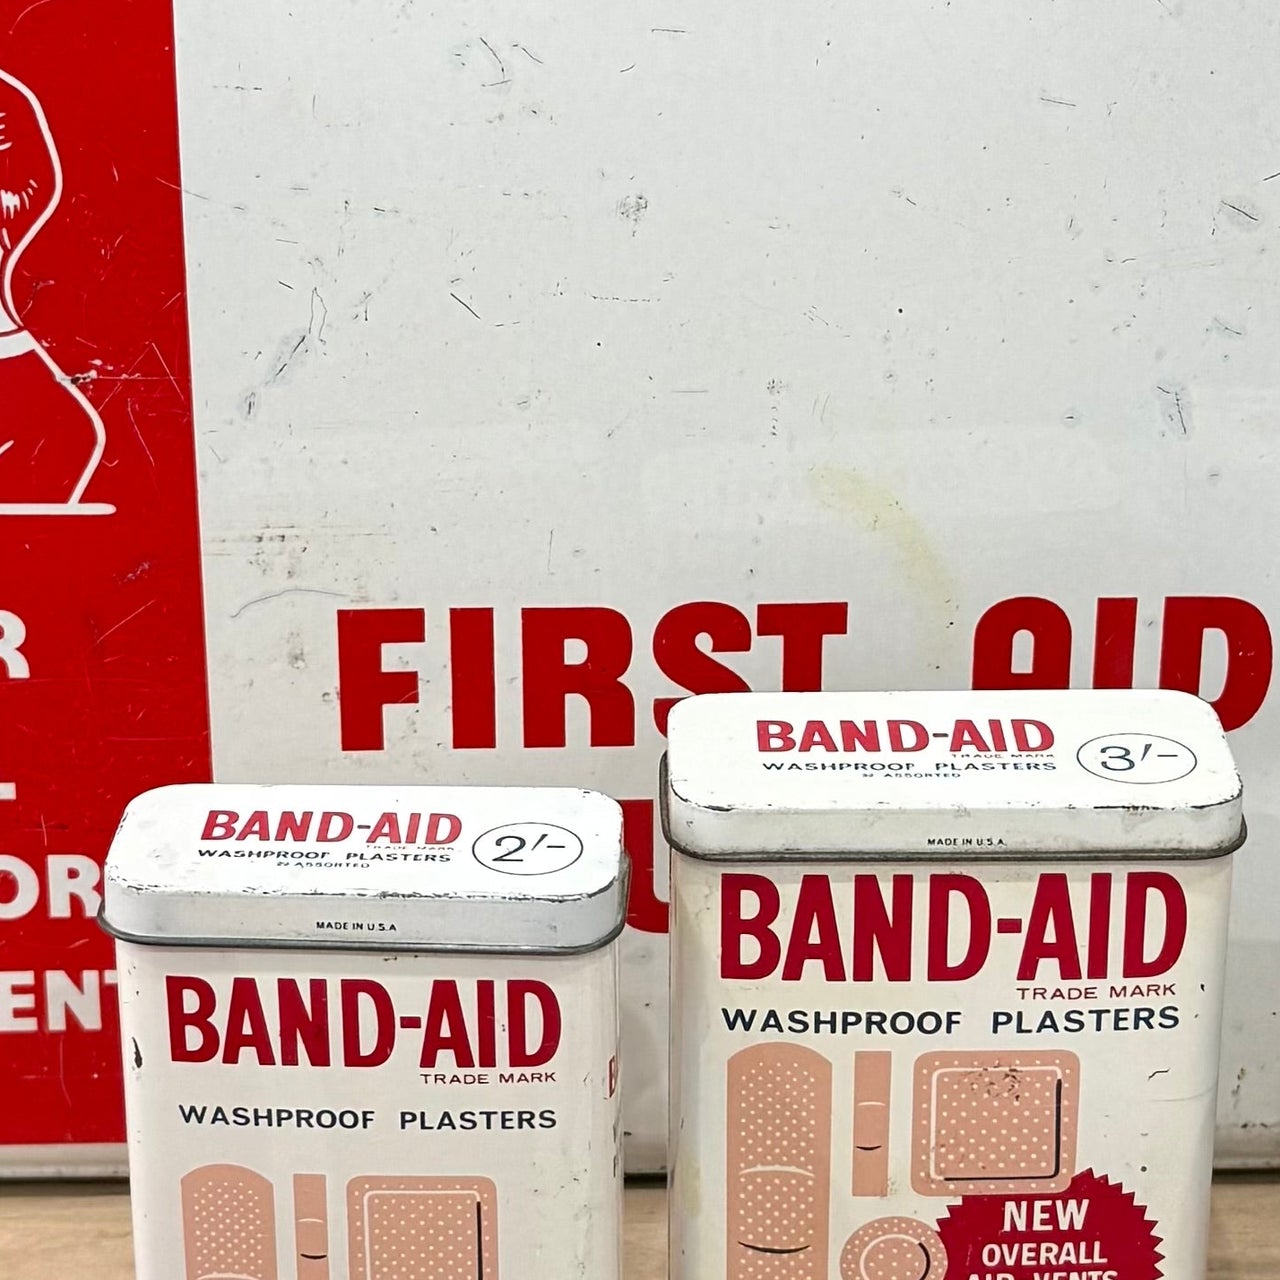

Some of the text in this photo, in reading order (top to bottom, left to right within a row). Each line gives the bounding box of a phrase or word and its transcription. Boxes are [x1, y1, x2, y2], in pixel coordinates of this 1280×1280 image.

[335, 595, 1274, 751] FIRST AID
[756, 719, 1054, 753] BAND-AID
[763, 761, 1057, 772] WASHPROOF PLASTERS
[200, 809, 463, 845] BAND-AID
[197, 848, 452, 863] WASHPROOF PLASTERS
[927, 837, 958, 847] MADE
[962, 838, 973, 846] IN
[316, 921, 349, 930] MADE
[352, 922, 364, 930] IN
[720, 871, 1187, 982] BAND-AID
[1016, 983, 1177, 1001] TRADE MARK
[165, 974, 562, 1069] BAND-AID
[721, 1005, 1181, 1035] WASHPROOF PLASTERS
[420, 1071, 558, 1085] TRADE MARK
[178, 1104, 558, 1131] WASHPROOF PLASTERS
[1002, 1198, 1090, 1233] NEW
[981, 1241, 1109, 1268] OVERALL
